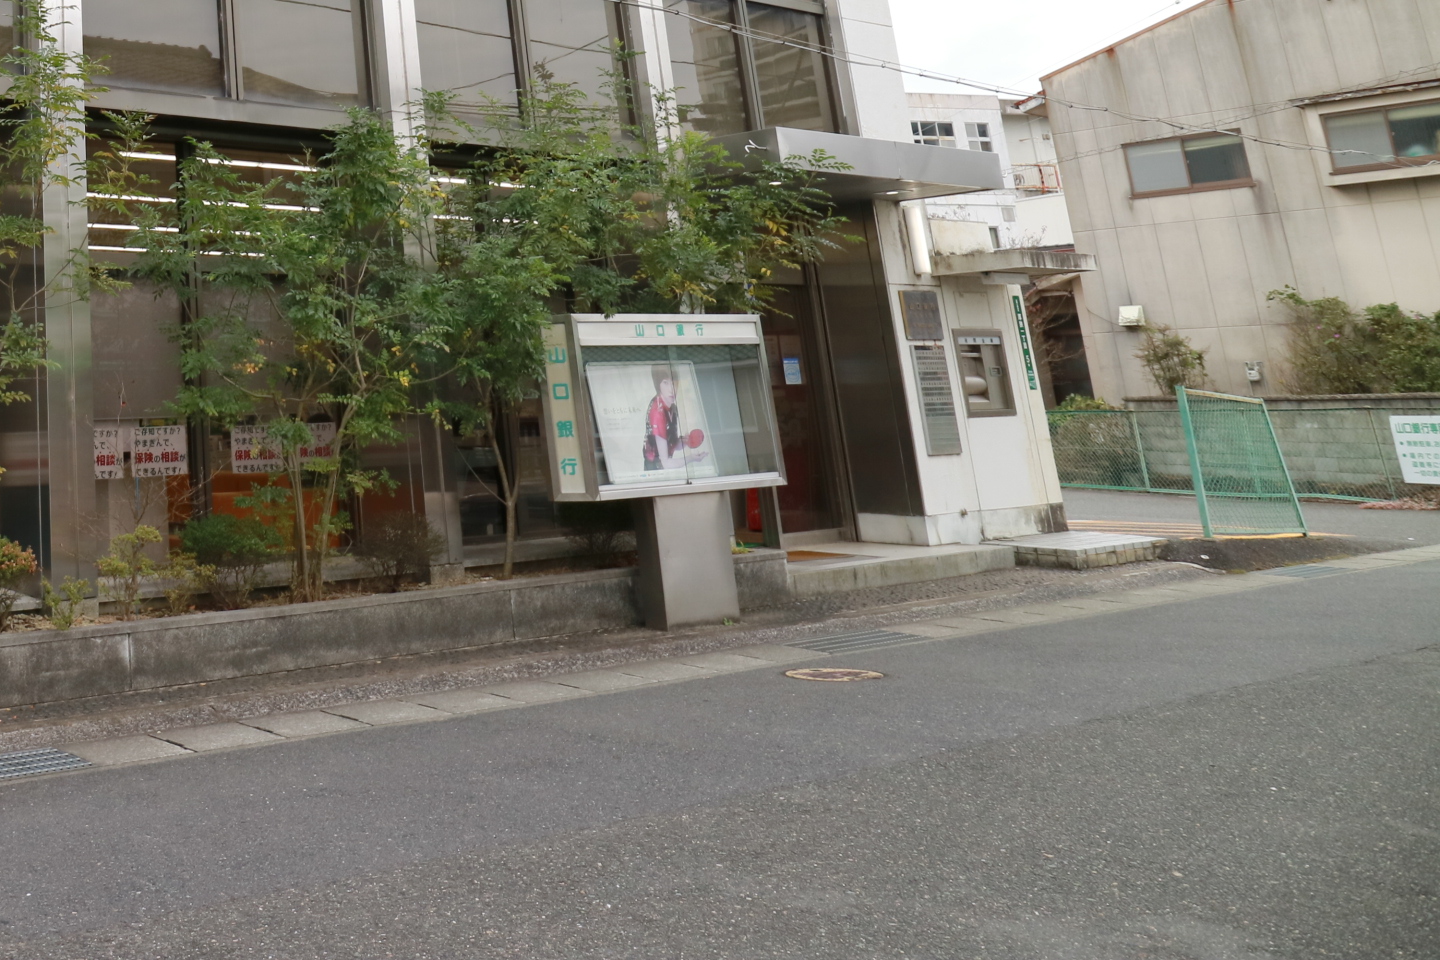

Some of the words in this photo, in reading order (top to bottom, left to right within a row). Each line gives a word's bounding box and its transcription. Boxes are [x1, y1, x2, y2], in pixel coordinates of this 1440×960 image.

[634, 323, 704, 337] 山口銀行
[547, 346, 578, 476] 山口銀行
[1395, 423, 1440, 434] 山口銀行専
